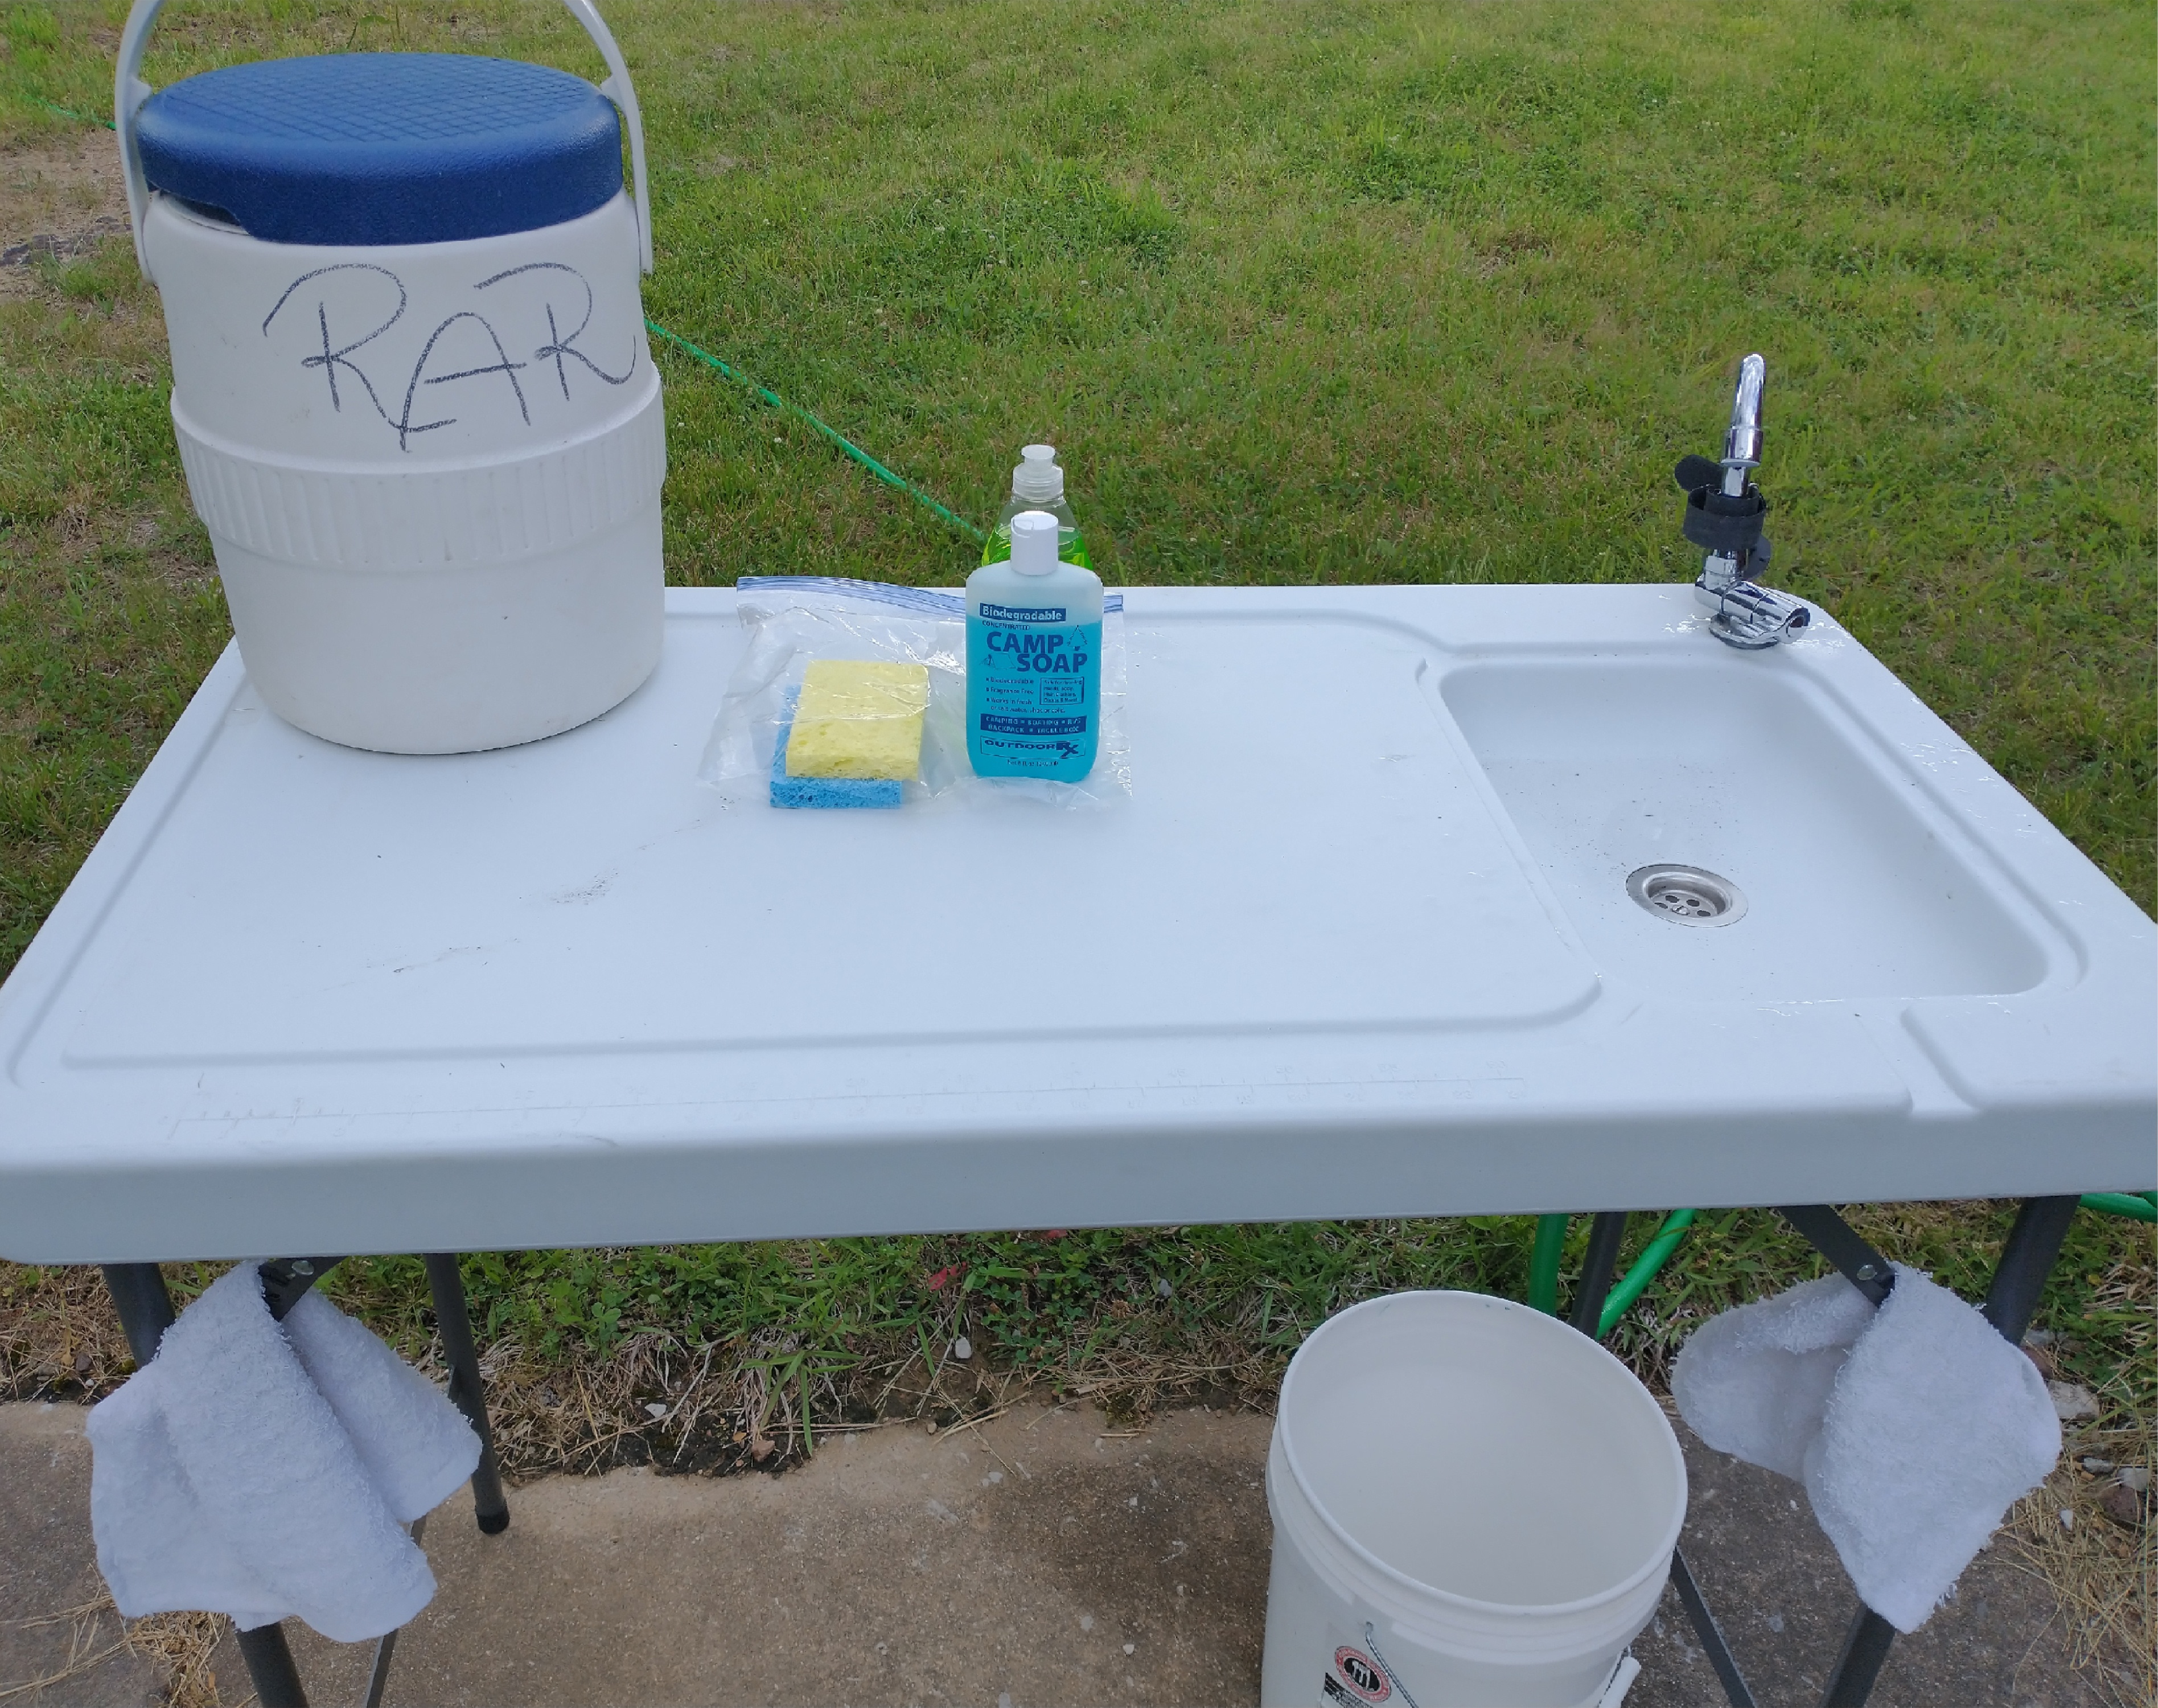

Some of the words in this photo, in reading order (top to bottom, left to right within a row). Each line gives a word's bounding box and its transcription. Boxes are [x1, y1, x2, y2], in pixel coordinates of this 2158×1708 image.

[983, 605, 1063, 621] Biodegradable
[982, 619, 1031, 631] CONCENTRATED
[986, 631, 1064, 654] CAMP
[1016, 652, 1088, 674] SOAP
[988, 724, 1025, 733] BACKPACK
